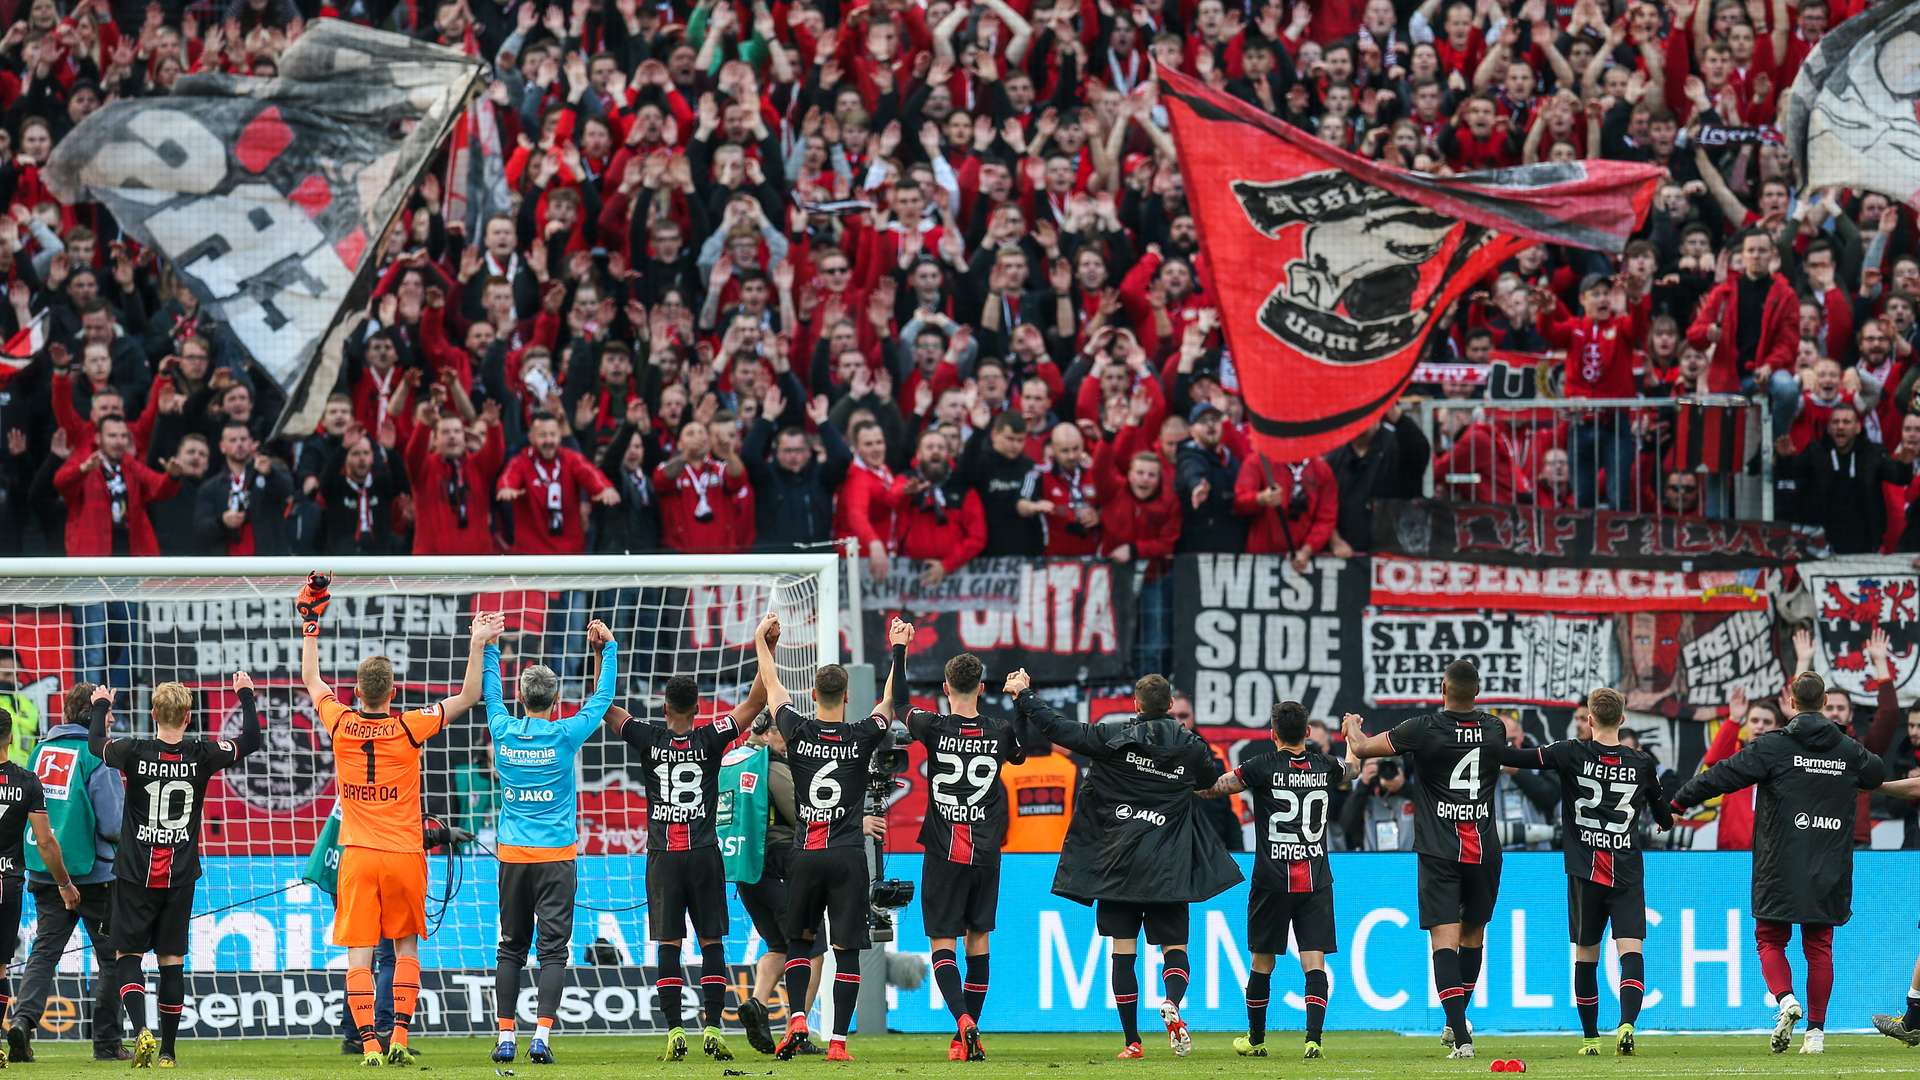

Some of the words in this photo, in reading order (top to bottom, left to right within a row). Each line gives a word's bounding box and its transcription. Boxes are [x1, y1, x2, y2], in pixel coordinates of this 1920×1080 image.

[1197, 553, 1347, 612] WEST
[1384, 560, 1686, 597] OFFENBACH
[147, 597, 459, 634] DURCHALTEN
[1195, 609, 1342, 674] SIDE
[1371, 620, 1524, 651] STADT
[1682, 611, 1775, 669] FREIHE
[1687, 653, 1736, 688] FÜR
[1738, 630, 1774, 677] DIE
[1373, 676, 1522, 694] AUFHEN
[1195, 669, 1342, 730] BOYZ
[344, 721, 396, 739] HRADECKY
[1455, 728, 1483, 743] TAH
[500, 744, 556, 759] Barmenia
[650, 745, 708, 763] WENDELL
[796, 740, 860, 760] DRAGOVIĆ
[938, 735, 999, 754] HAVERTZ
[138, 760, 198, 778] BRANDT
[360, 740, 376, 785] 1
[1125, 751, 1186, 776] Barma
[1136, 764, 1179, 780] Versicherungen
[1583, 760, 1637, 781] WEISER
[1793, 755, 1847, 771] Barmenia
[932, 752, 998, 807] 29
[1272, 772, 1286, 787] CH.
[1288, 769, 1329, 788] ARÁNGUIZ
[1449, 746, 1481, 800] 4
[0, 786, 23, 802] NHO
[343, 783, 377, 802] BAYER
[379, 786, 399, 801] 04
[653, 762, 704, 808] 18
[808, 759, 842, 809] 6
[144, 780, 194, 830] 10
[518, 789, 554, 802] JAKO
[1574, 775, 1639, 834] 23
[651, 804, 689, 823] BAYER
[689, 804, 707, 820] 04
[799, 803, 832, 822] BAYER
[936, 803, 968, 822] AYER
[970, 805, 987, 821] 04
[1132, 809, 1167, 826] JAKO
[1268, 788, 1329, 843] 20
[1437, 801, 1474, 821] BAYER
[1475, 802, 1489, 820] 04
[1811, 816, 1842, 831] JAKO
[136, 824, 173, 844] BAYER
[174, 826, 190, 844] 04
[1613, 833, 1632, 850] 04
[1271, 843, 1308, 860] BAYER
[1308, 843, 1324, 858] 04
